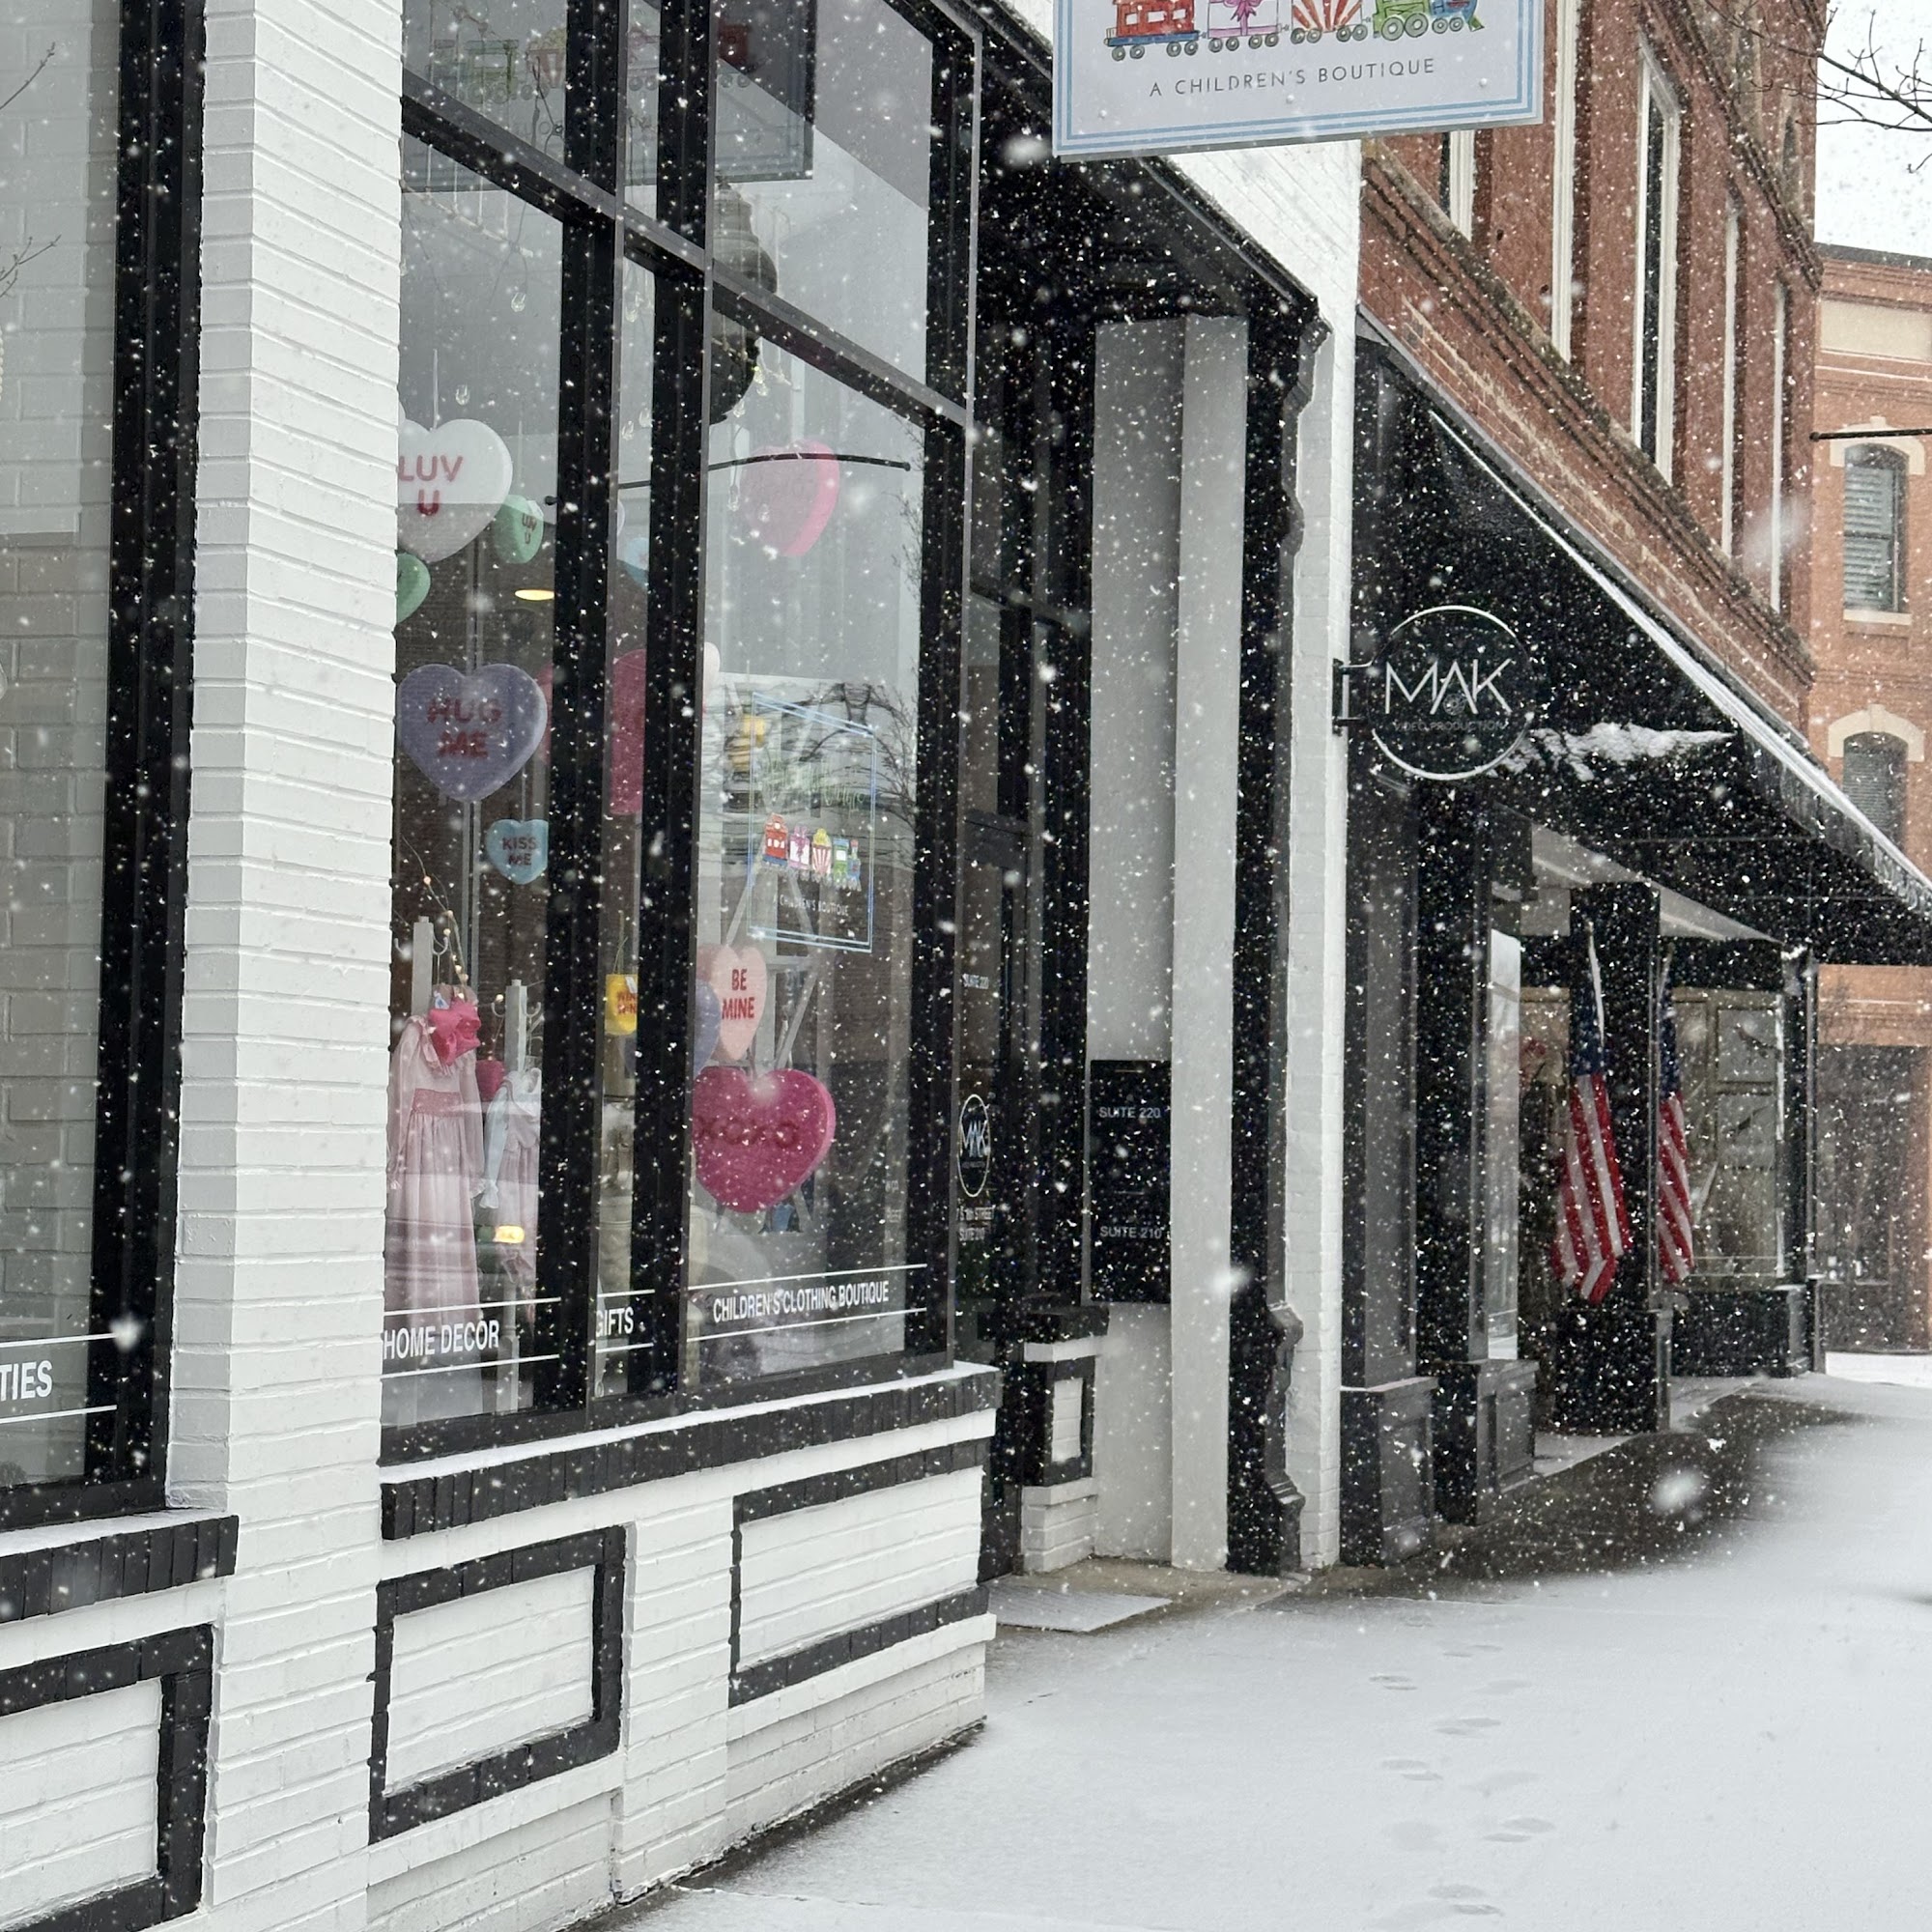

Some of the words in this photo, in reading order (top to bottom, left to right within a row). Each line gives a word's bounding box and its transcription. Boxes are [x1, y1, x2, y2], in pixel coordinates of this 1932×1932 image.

[1150, 82, 1163, 98] A
[1175, 68, 1306, 96] CHILDREN'S
[1319, 58, 1436, 84] BOUTIQUE
[397, 454, 464, 482] LUV
[416, 489, 440, 516] U
[1384, 658, 1514, 715] MAK
[426, 696, 503, 724] HUG
[438, 730, 490, 758] ME
[502, 836, 537, 851] KISS
[508, 853, 532, 866] ME
[731, 969, 748, 992] BE
[721, 996, 755, 1021] MINE
[1098, 1106, 1136, 1119] SUITE
[1138, 1107, 1161, 1119] 220
[1099, 1225, 1137, 1238] SUITE
[1140, 1227, 1162, 1240] 210
[713, 1291, 781, 1323] CHILDREN'S
[782, 1285, 836, 1314] CLOTHING
[838, 1280, 890, 1307] BOUTIQUE
[383, 1325, 437, 1360] HOME
[440, 1319, 500, 1353] DECOR
